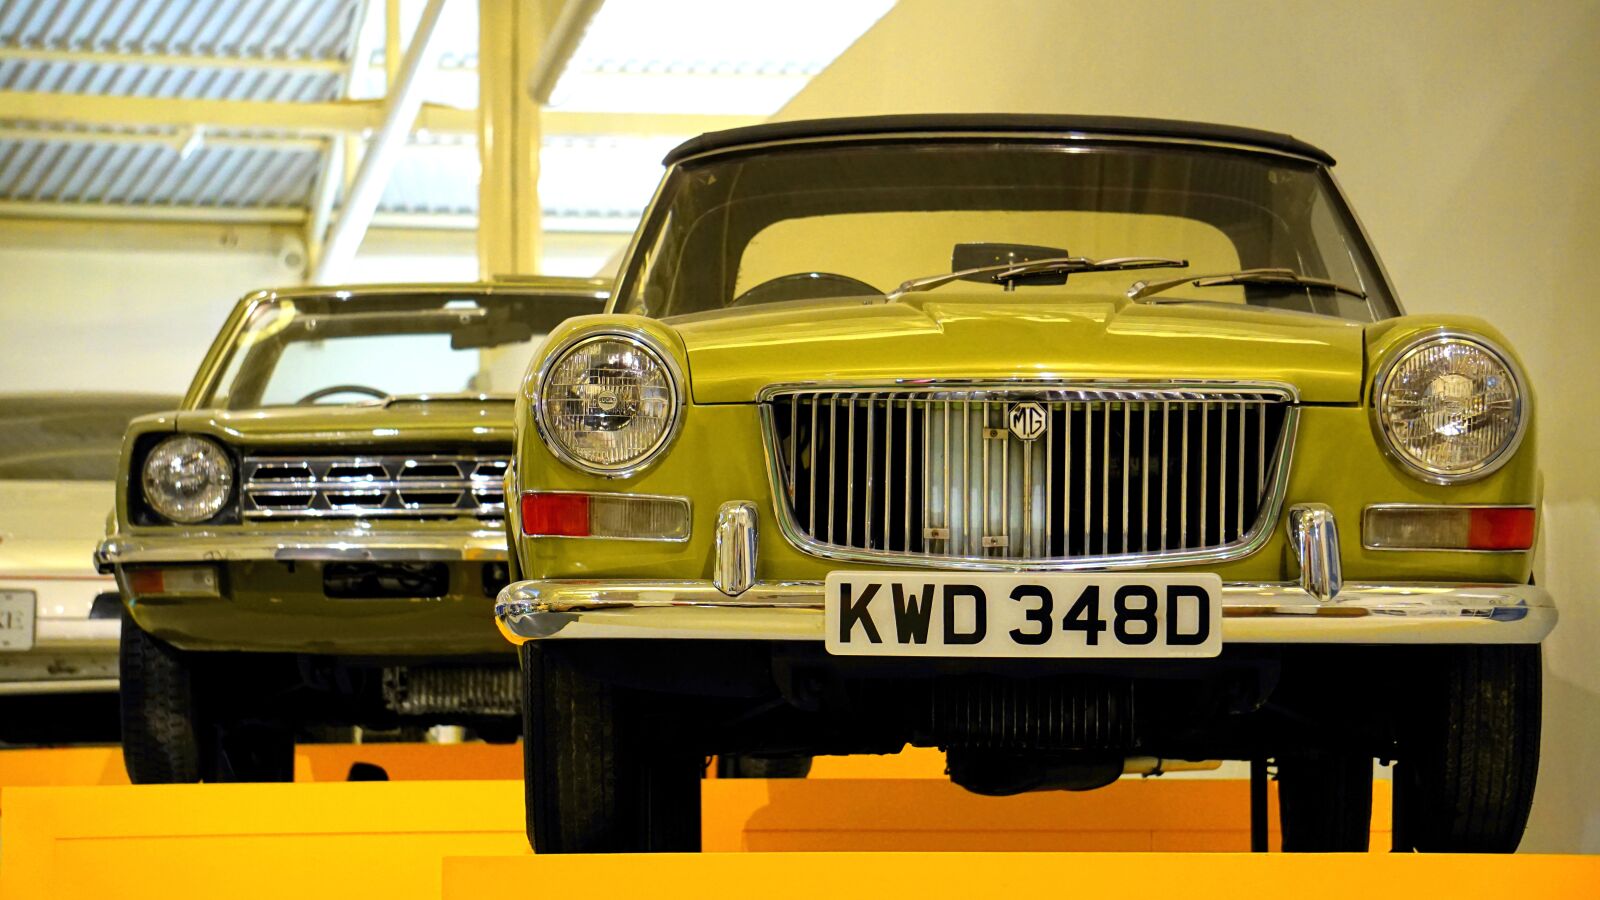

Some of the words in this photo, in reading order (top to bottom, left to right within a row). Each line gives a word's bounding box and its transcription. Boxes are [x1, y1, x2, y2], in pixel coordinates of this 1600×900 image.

[1012, 405, 1043, 436] MG
[839, 582, 988, 645] KWD
[1008, 584, 1211, 646] 348D
